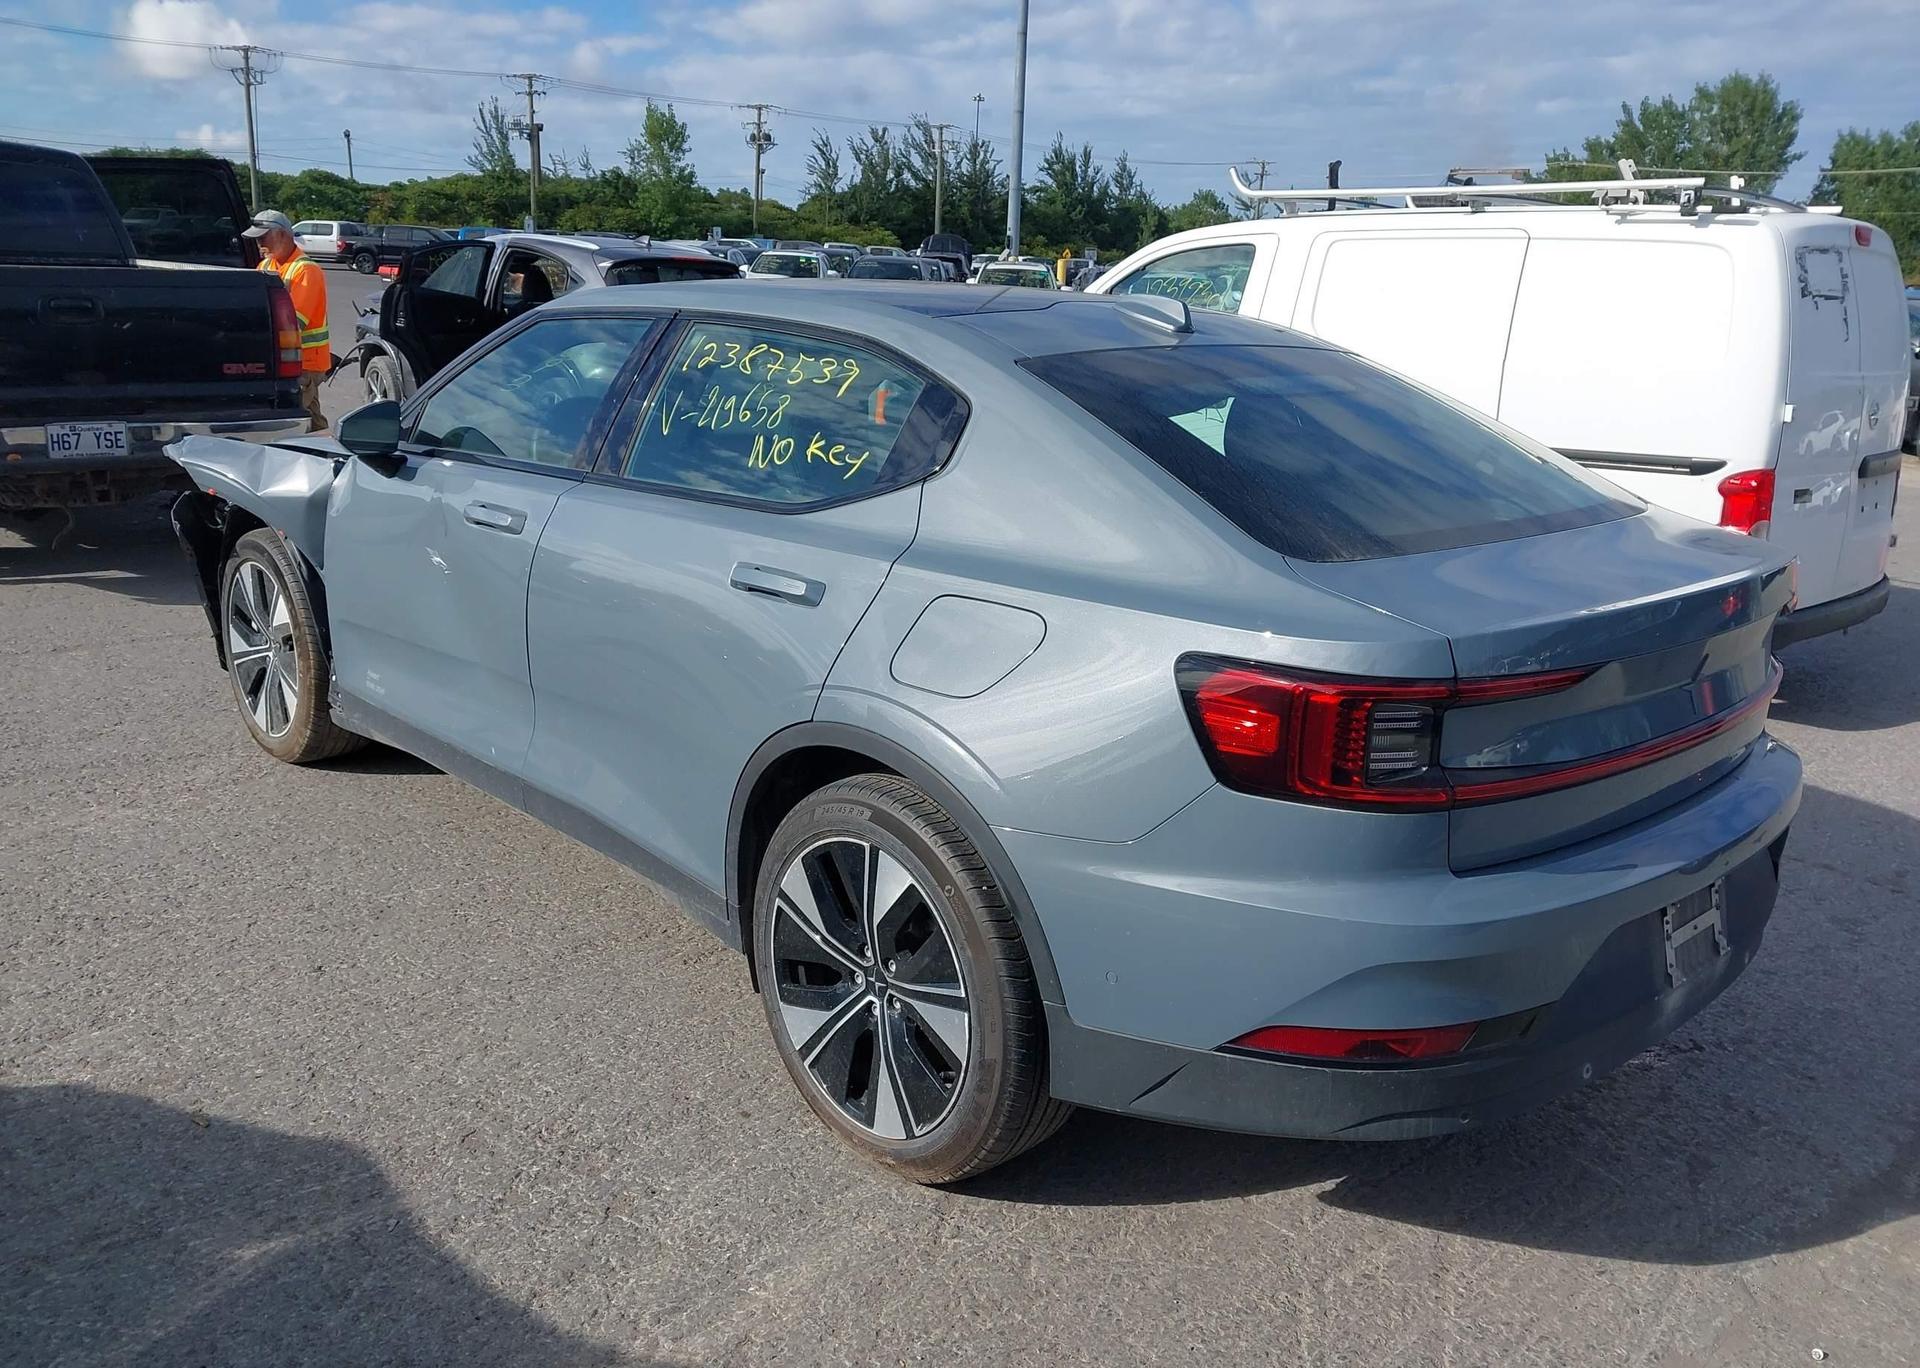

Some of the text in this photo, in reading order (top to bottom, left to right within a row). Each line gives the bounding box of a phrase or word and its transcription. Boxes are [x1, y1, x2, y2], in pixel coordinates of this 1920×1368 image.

[223, 362, 266, 375] GMC
[682, 335, 861, 398] 12387539
[50, 430, 125, 452] H67 YSE
[748, 434, 794, 469] NO
[855, 808, 865, 818] 19
